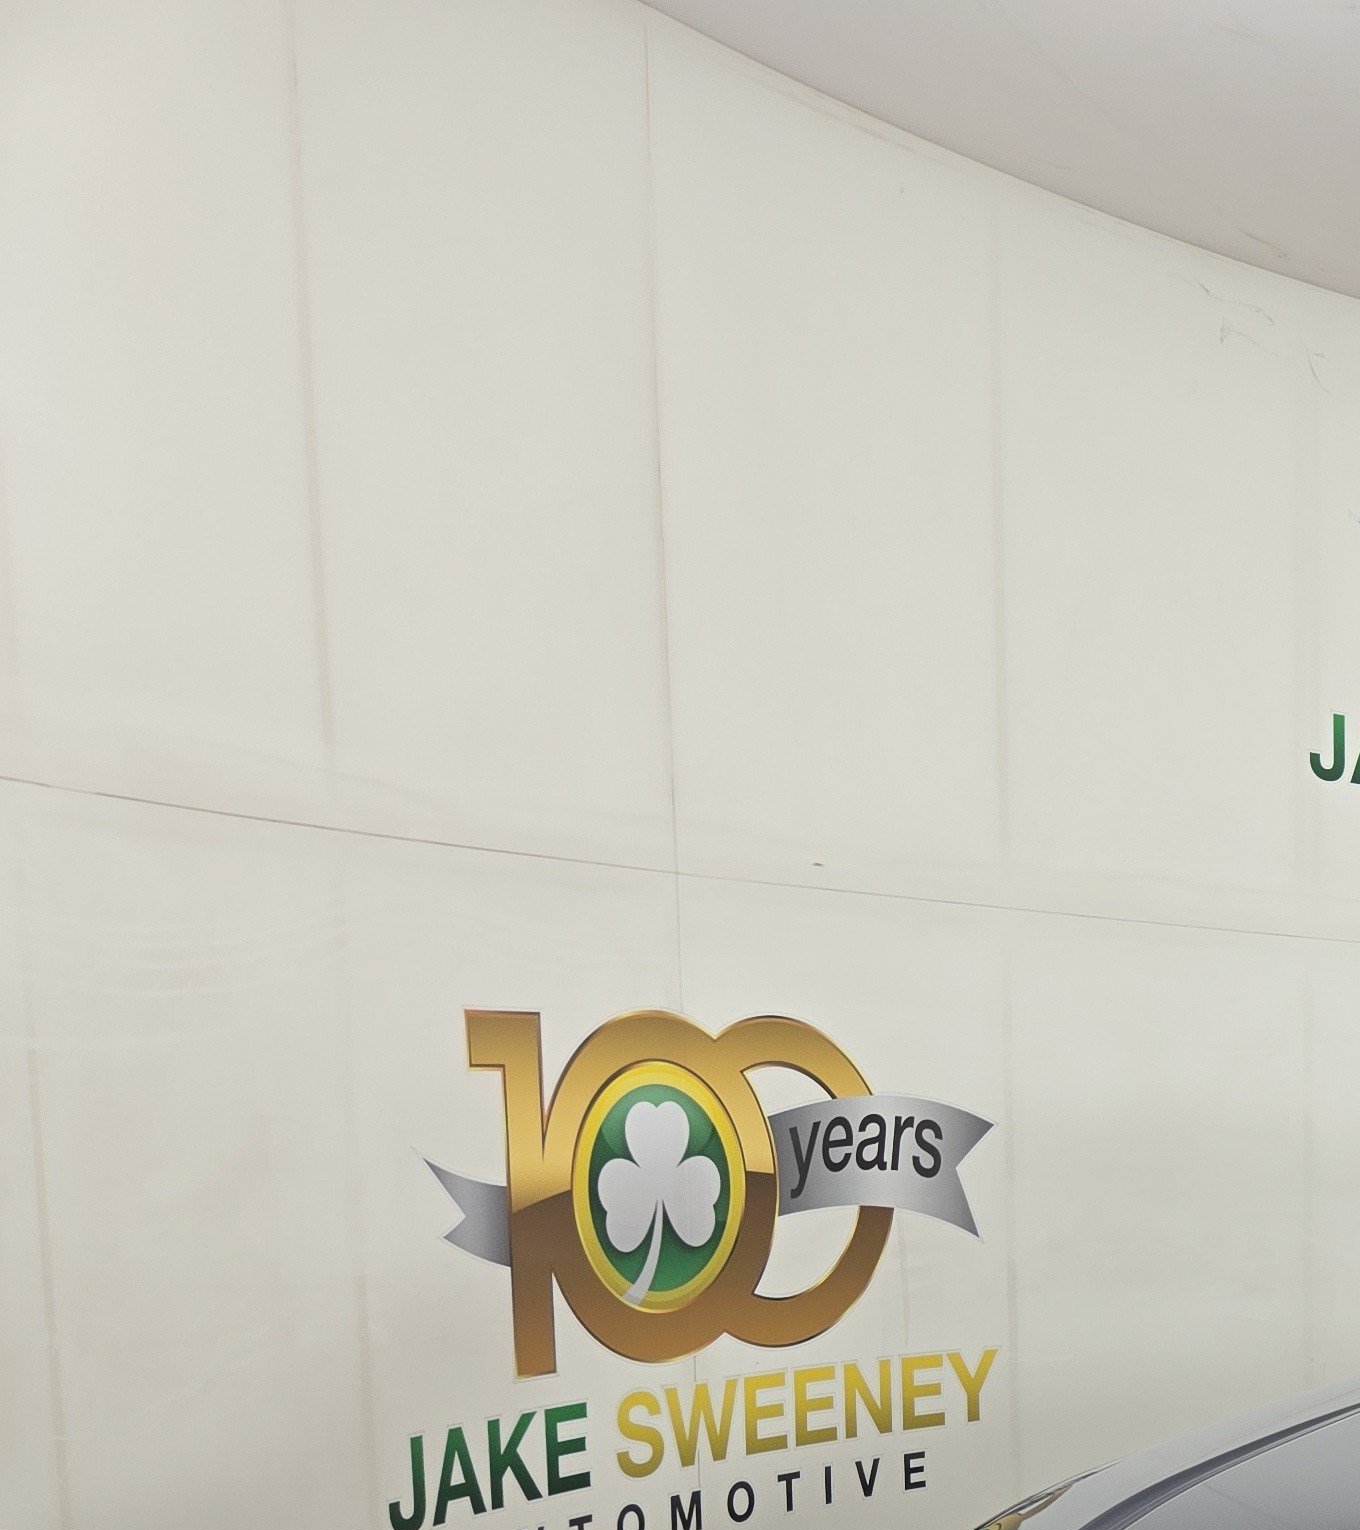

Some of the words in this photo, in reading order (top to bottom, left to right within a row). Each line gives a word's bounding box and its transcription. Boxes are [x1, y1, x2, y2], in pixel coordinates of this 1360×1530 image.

[464, 1009, 895, 1378] 100
[789, 1112, 943, 1198] years
[616, 1348, 998, 1478] SWEENEY
